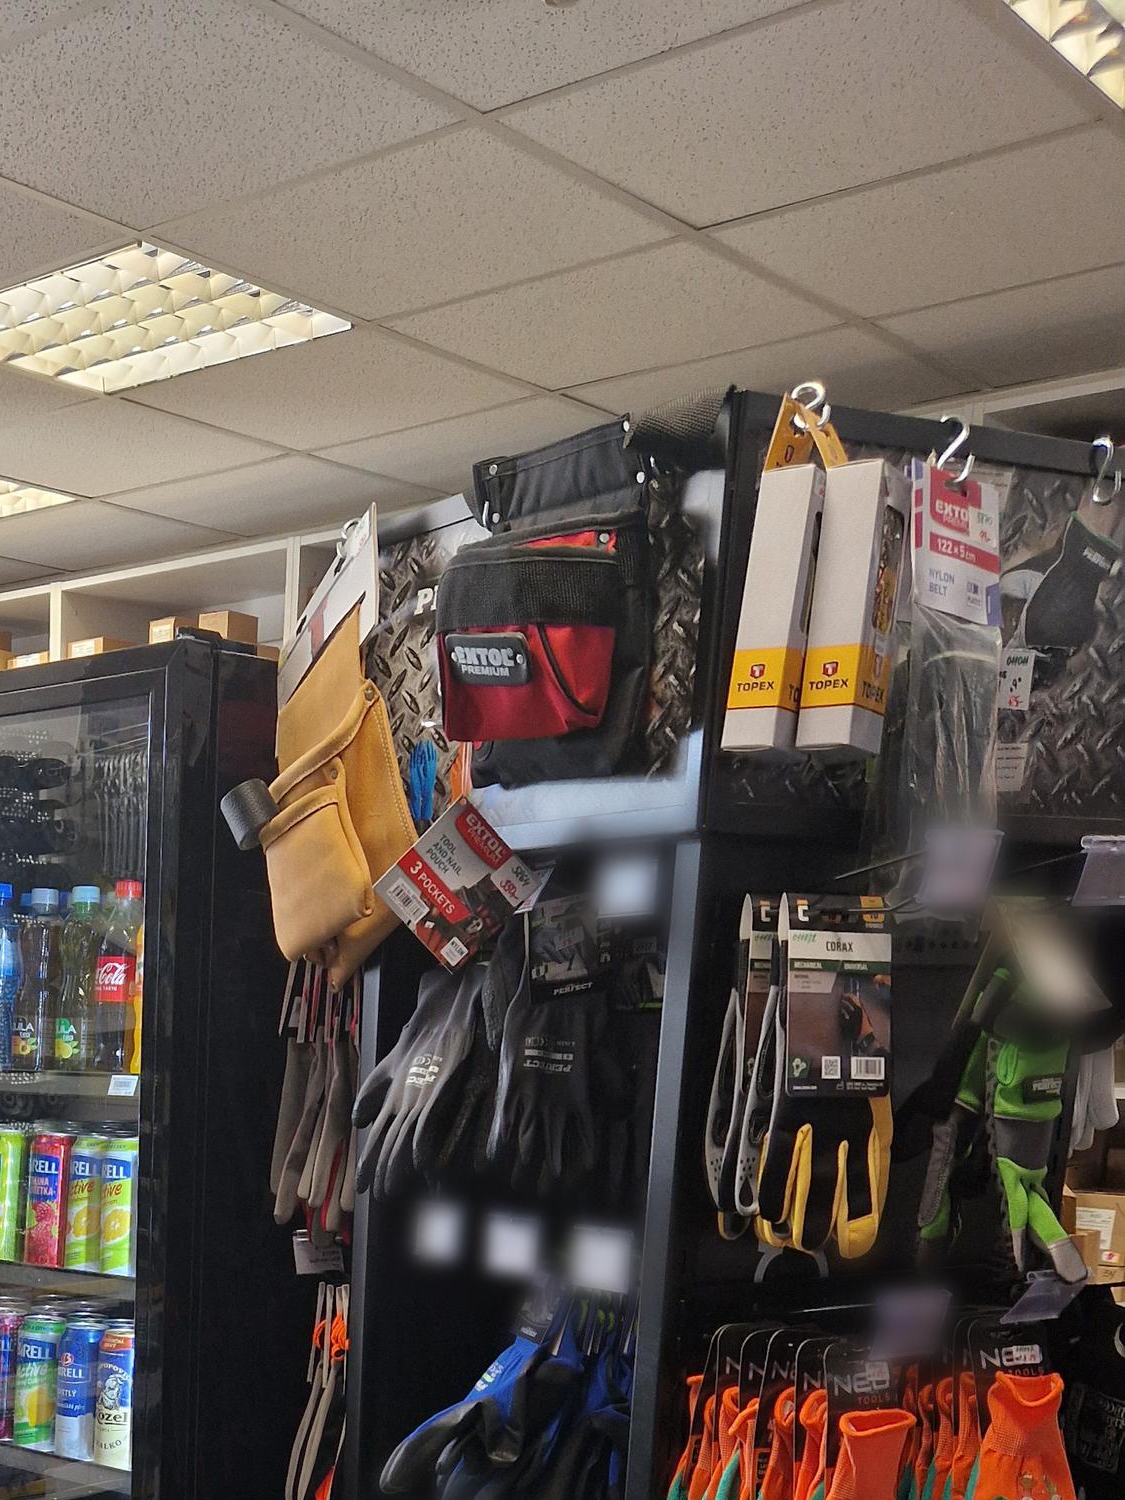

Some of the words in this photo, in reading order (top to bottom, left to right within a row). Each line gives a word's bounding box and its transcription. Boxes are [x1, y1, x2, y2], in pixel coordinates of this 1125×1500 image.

[935, 499, 969, 521] EXTO
[929, 568, 955, 585] NYLON
[929, 580, 948, 596] BELT
[455, 646, 515, 667] EXTOL
[461, 664, 510, 676] PREMIUM
[737, 680, 774, 692] TOPEX
[809, 678, 849, 691] TOPEX
[439, 833, 456, 855] TOOL
[466, 813, 506, 861] EXTOL
[426, 849, 450, 875] POUCH
[432, 841, 448, 860] AND
[445, 857, 465, 876] NAIL
[410, 860, 422, 875] 3
[417, 870, 456, 915] POCKETS
[825, 940, 854, 952] CORAX
[99, 962, 131, 985] Cola
[553, 980, 594, 996] PERFECT
